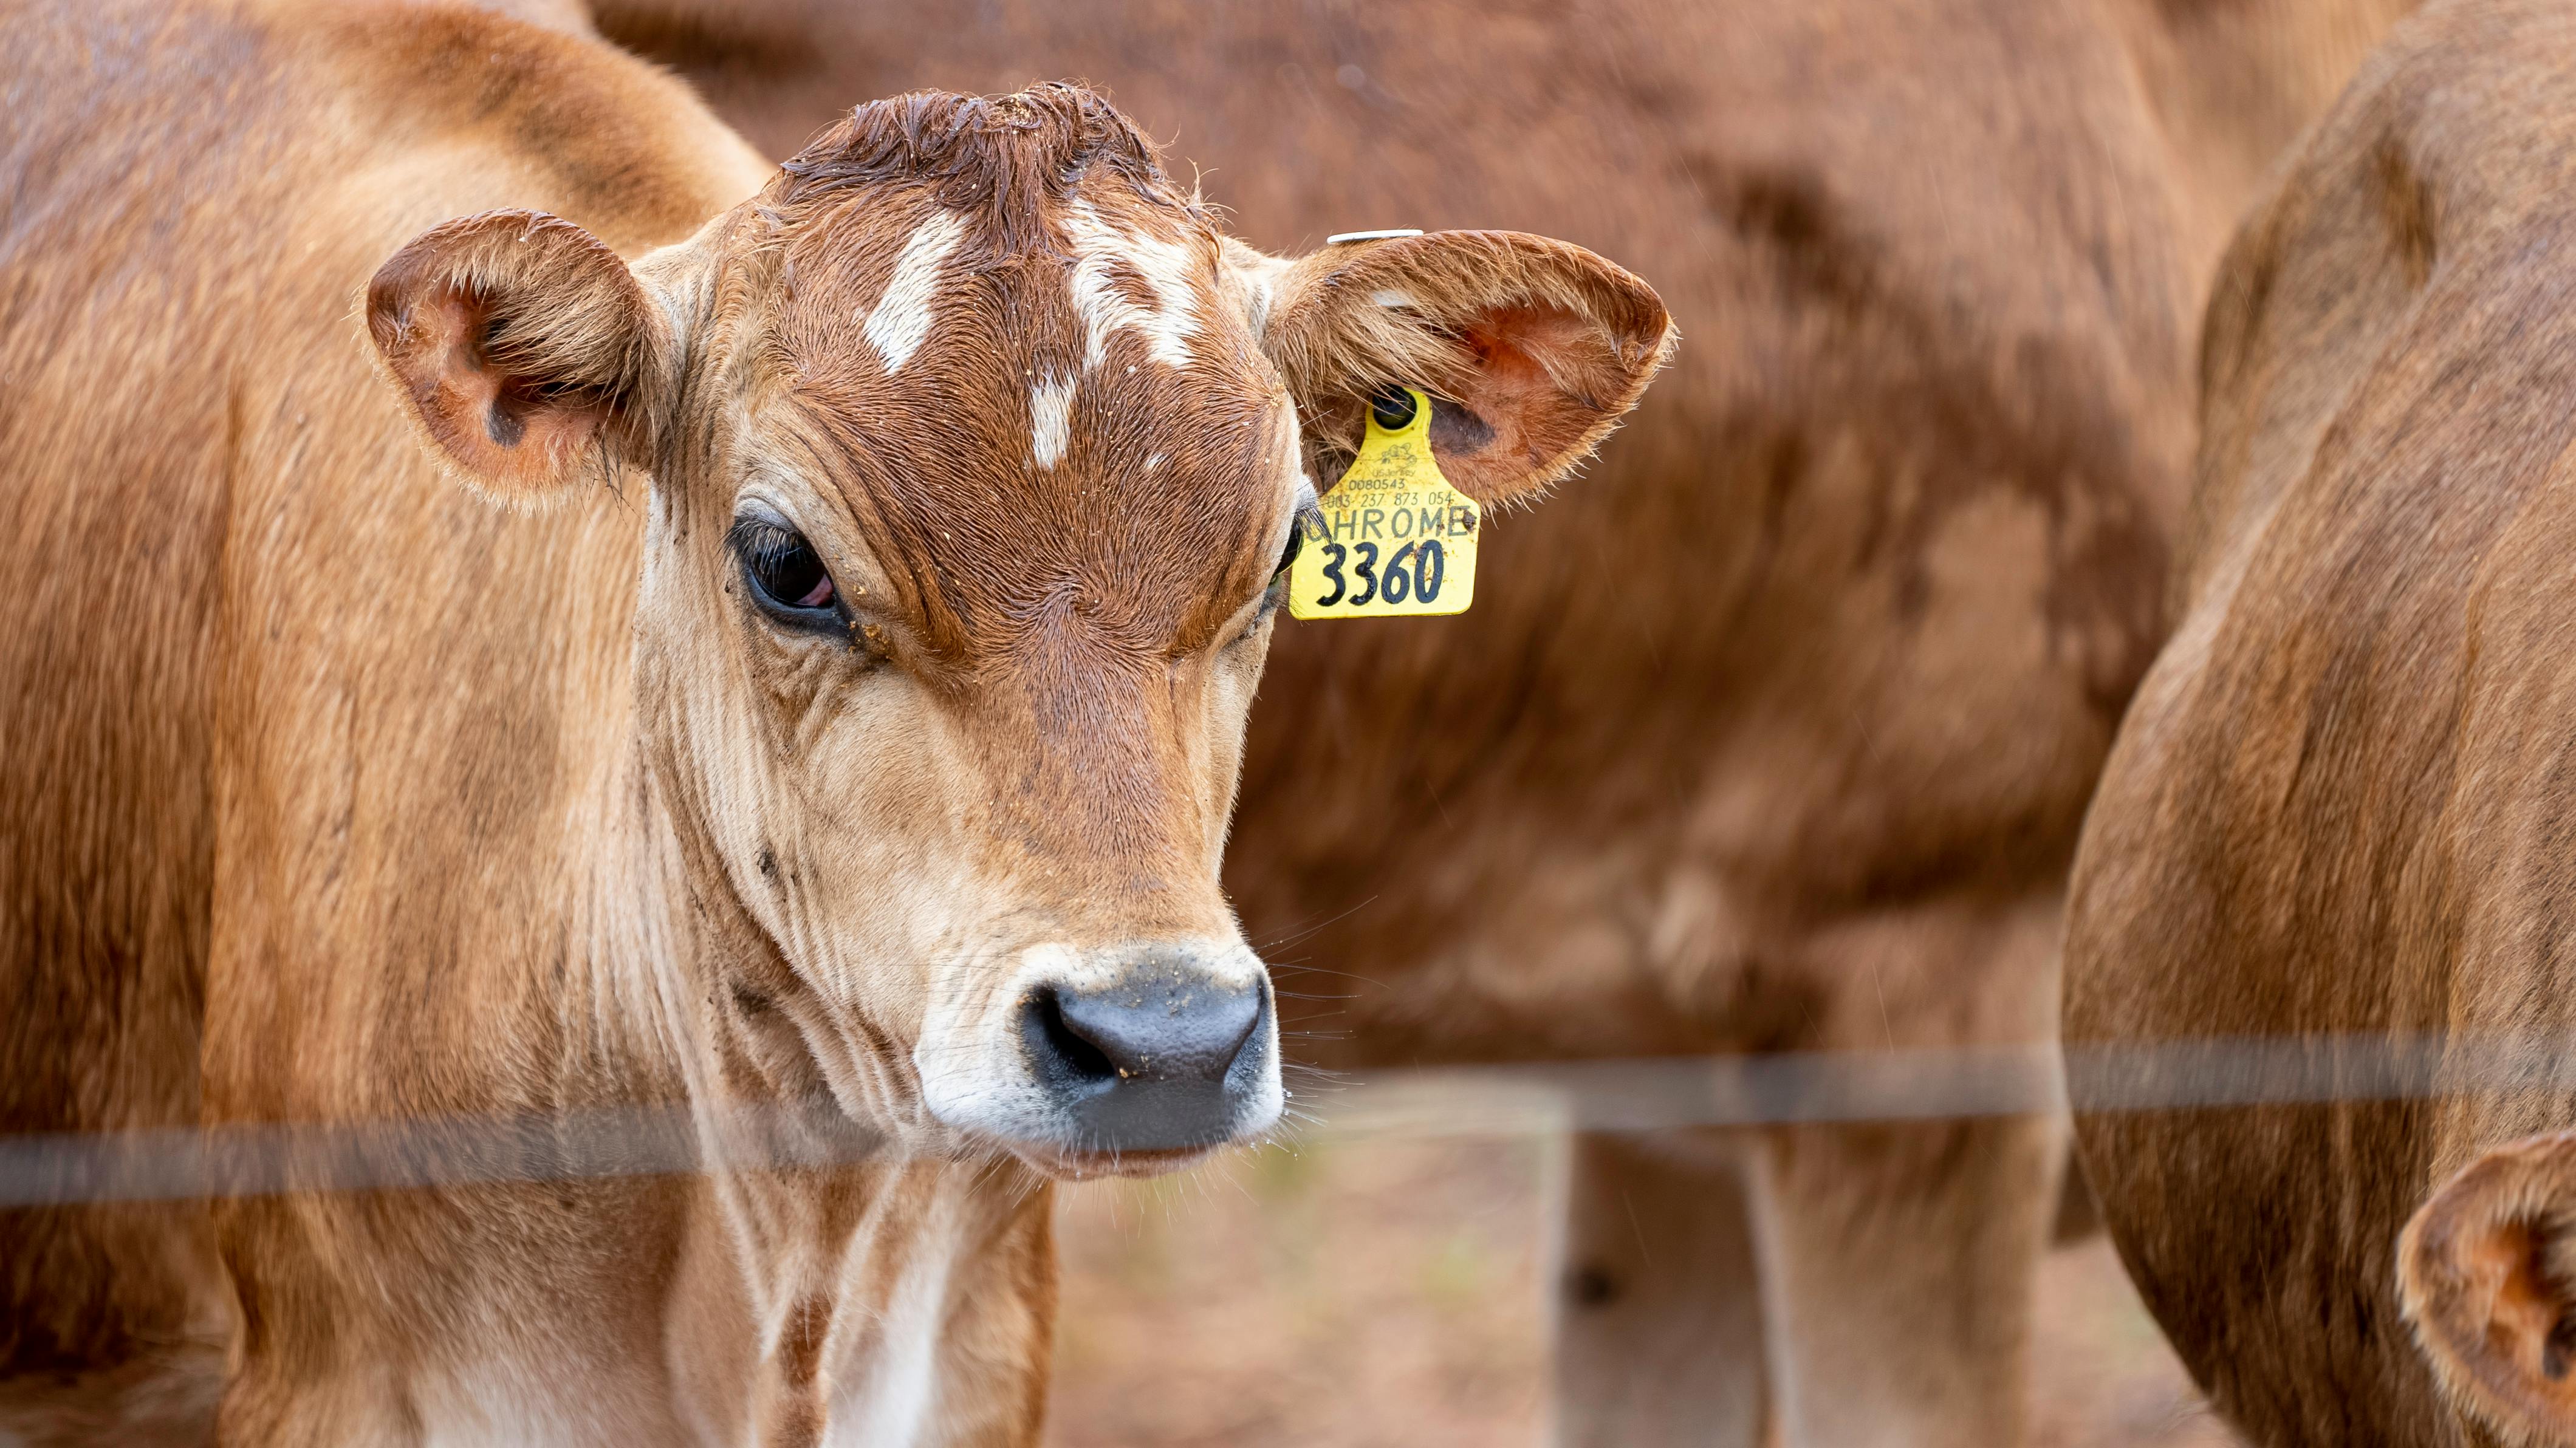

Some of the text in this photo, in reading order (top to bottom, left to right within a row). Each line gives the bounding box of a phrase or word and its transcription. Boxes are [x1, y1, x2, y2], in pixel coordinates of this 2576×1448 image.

[1348, 478, 1405, 491] 0080543
[1360, 493, 1385, 507] 237
[1394, 492, 1418, 505] 873
[1428, 491, 1451, 505] 054
[1316, 539, 1444, 607] 3360
